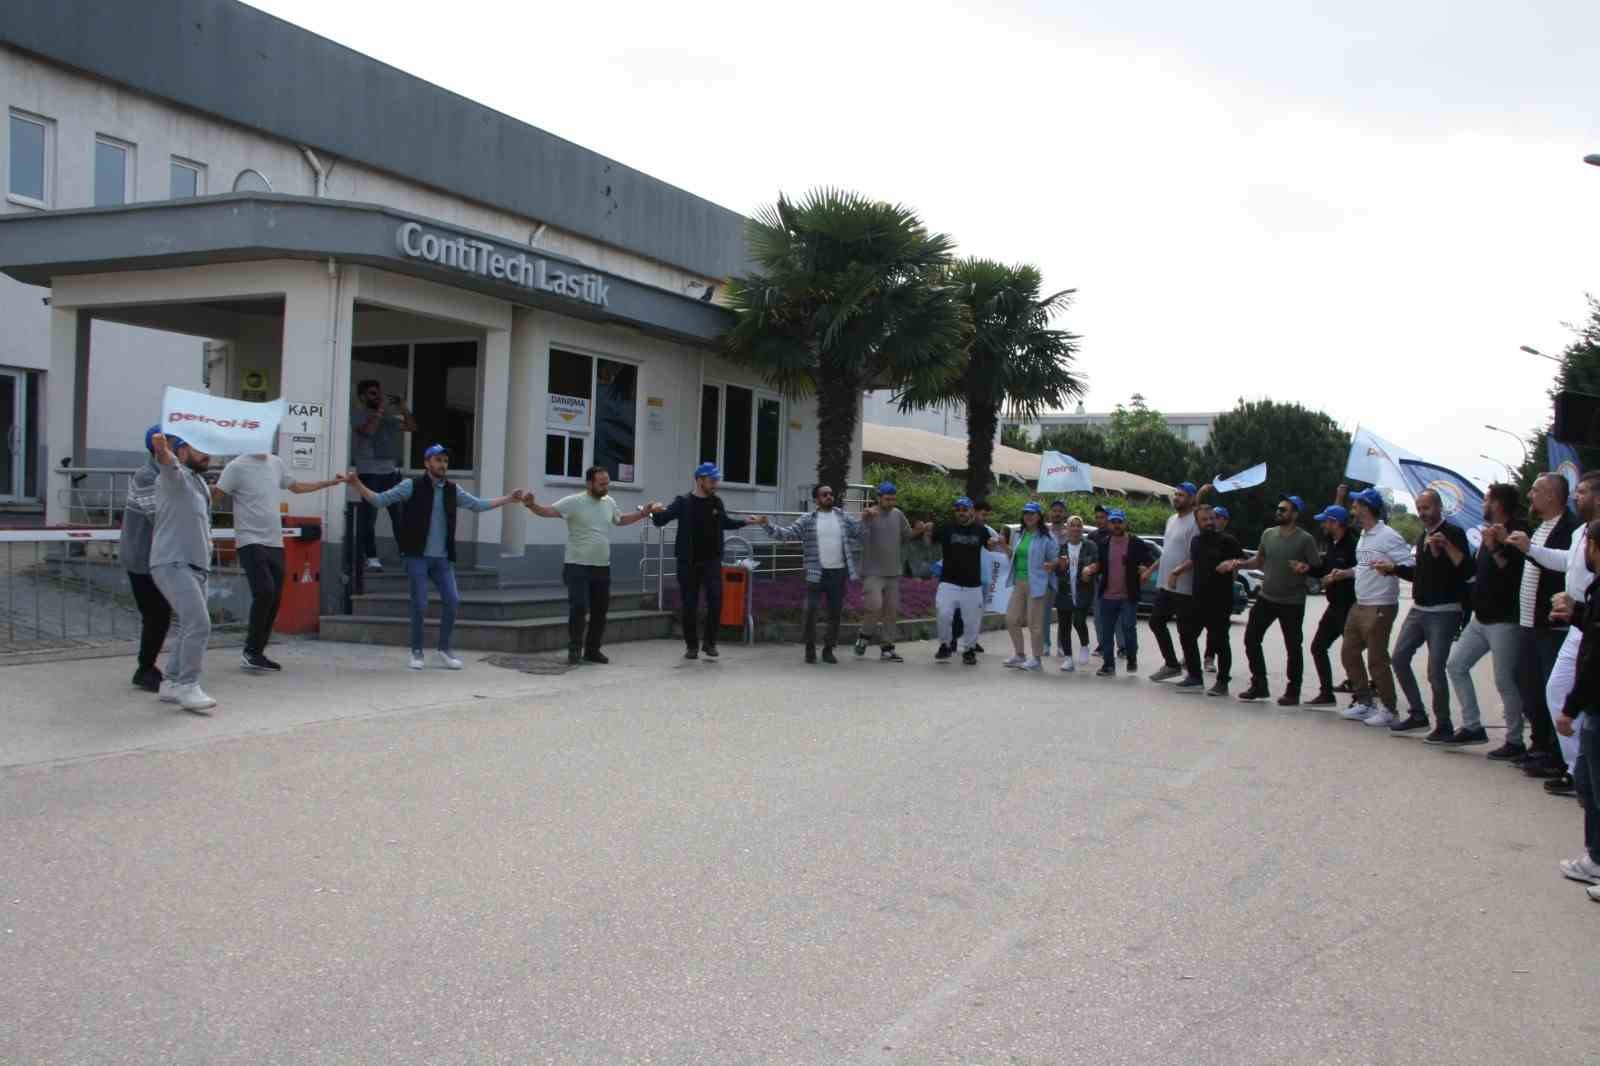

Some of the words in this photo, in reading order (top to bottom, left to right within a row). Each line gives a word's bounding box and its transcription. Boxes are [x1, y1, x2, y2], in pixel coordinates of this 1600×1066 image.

[395, 222, 533, 289] ContiTech
[535, 258, 609, 307] Lastik
[288, 403, 323, 417] KAPI
[300, 420, 307, 432] 1
